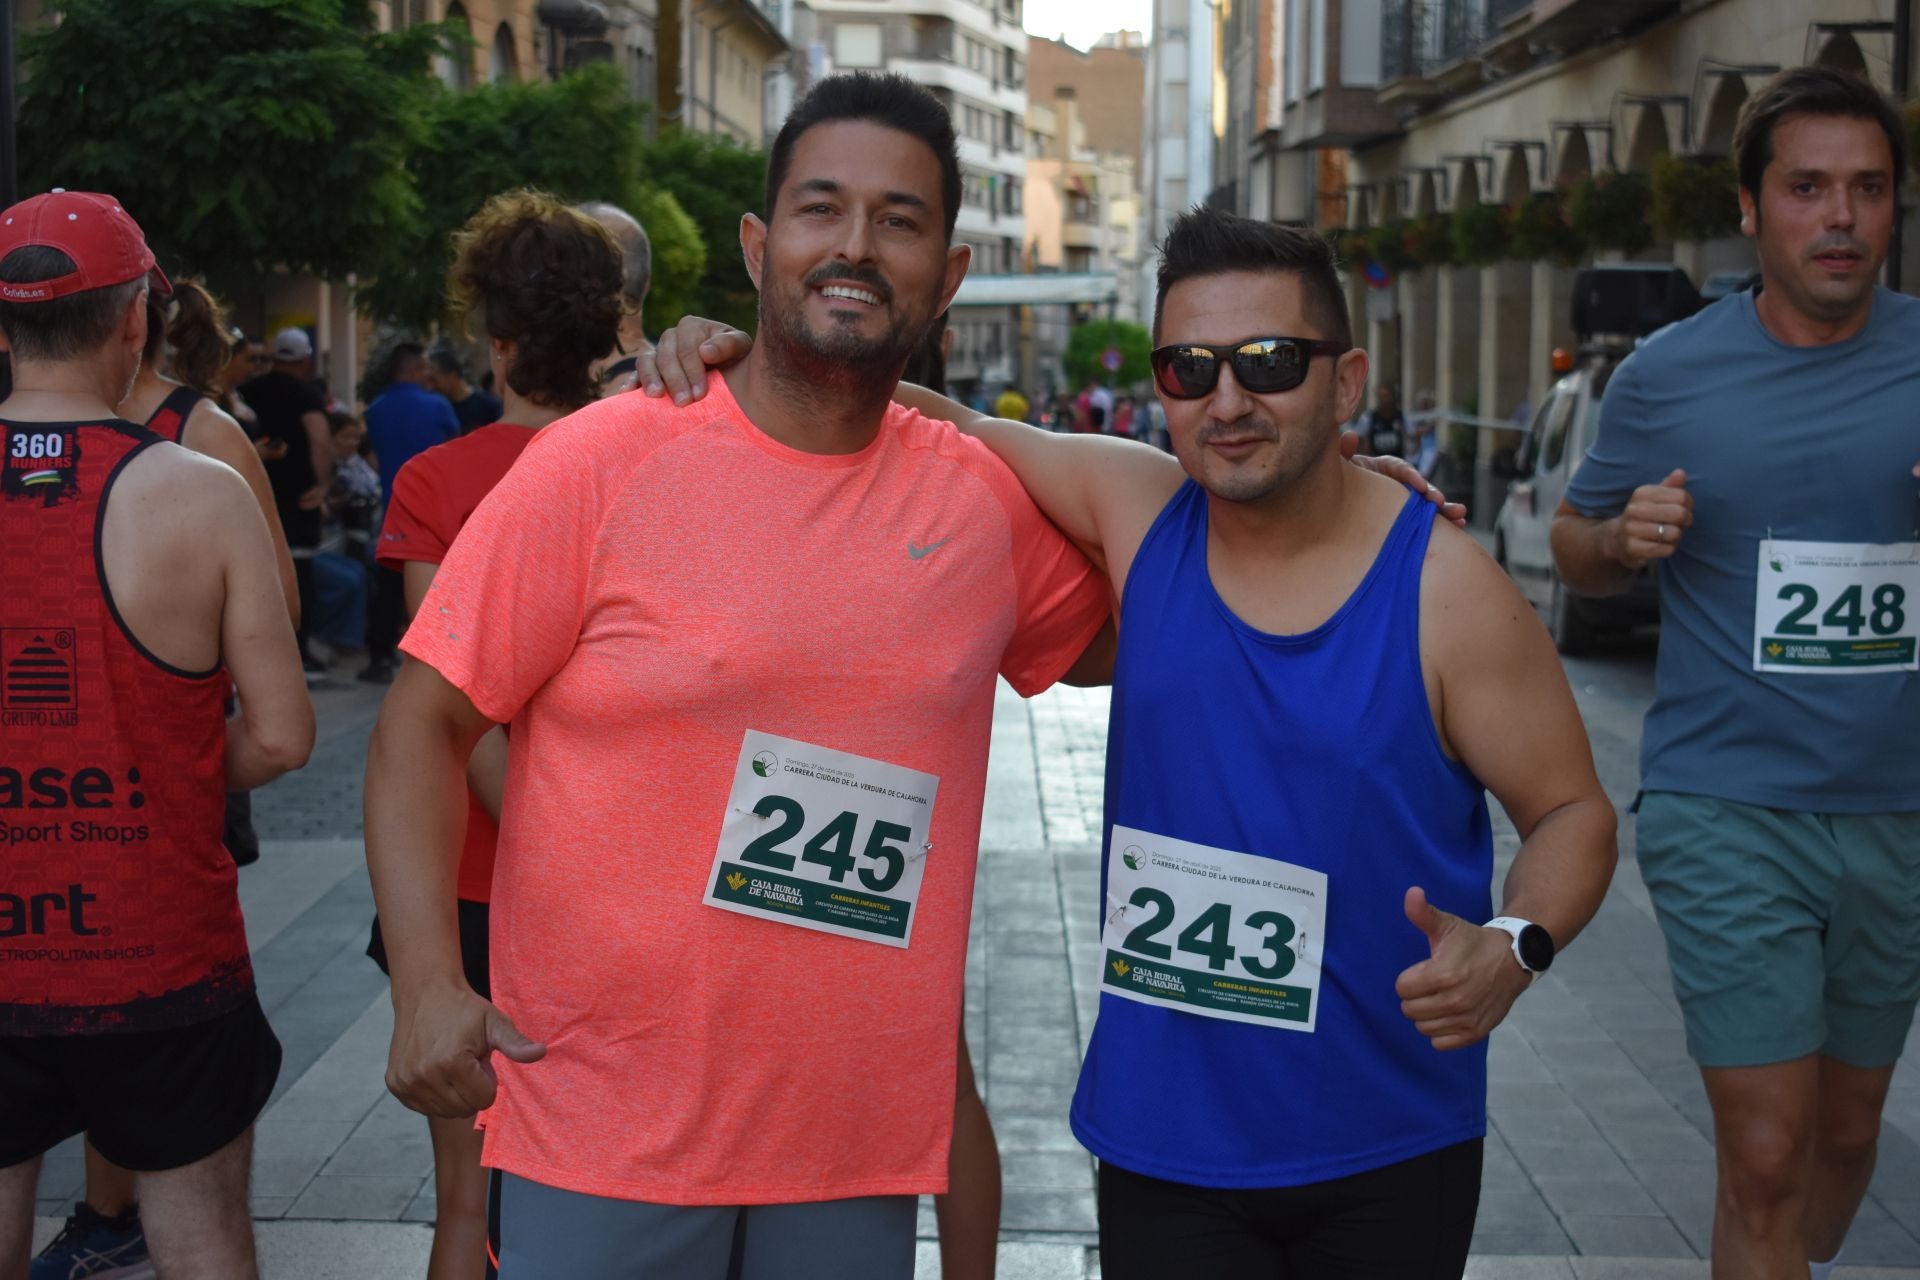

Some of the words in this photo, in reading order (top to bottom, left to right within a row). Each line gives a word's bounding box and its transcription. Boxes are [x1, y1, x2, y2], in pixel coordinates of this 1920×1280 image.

[11, 433, 63, 458] 360
[10, 457, 73, 469] RUNNERS
[1774, 583, 1906, 636] 248
[1, 711, 47, 727] GRUPO
[50, 711, 79, 727] LMB
[784, 765, 814, 777] CARRERA
[815, 772, 841, 784] CIUDAD
[841, 778, 850, 786] DE
[850, 780, 858, 788] LA
[860, 783, 887, 795] VERDURA
[887, 789, 895, 797] DE
[896, 791, 927, 806] CALAHORRA
[70, 820, 149, 847] Shops
[740, 795, 912, 892] 245
[1151, 858, 1180, 871] CARRERA
[1181, 865, 1207, 877] CIUDAD
[1208, 871, 1217, 879] DE
[1229, 876, 1261, 886] VERDURA
[1262, 880, 1272, 888] DE
[1273, 881, 1315, 897] CALAHORRA
[749, 886, 762, 896] DE
[763, 890, 804, 906] NAVARRA
[751, 879, 772, 890] CAJA
[773, 883, 802, 897] RURAL
[831, 893, 860, 905] CARRERAS
[860, 899, 891, 911] INFANTILES
[1122, 886, 1296, 980] 243
[104, 944, 156, 960] SHOES
[1132, 973, 1144, 983] DE
[1146, 977, 1186, 992] NAVARRA
[1133, 966, 1152, 977] CAJA
[1154, 971, 1183, 984] RURAL
[1213, 980, 1248, 991] CARRERAS
[1248, 986, 1287, 998] INFANTILES
